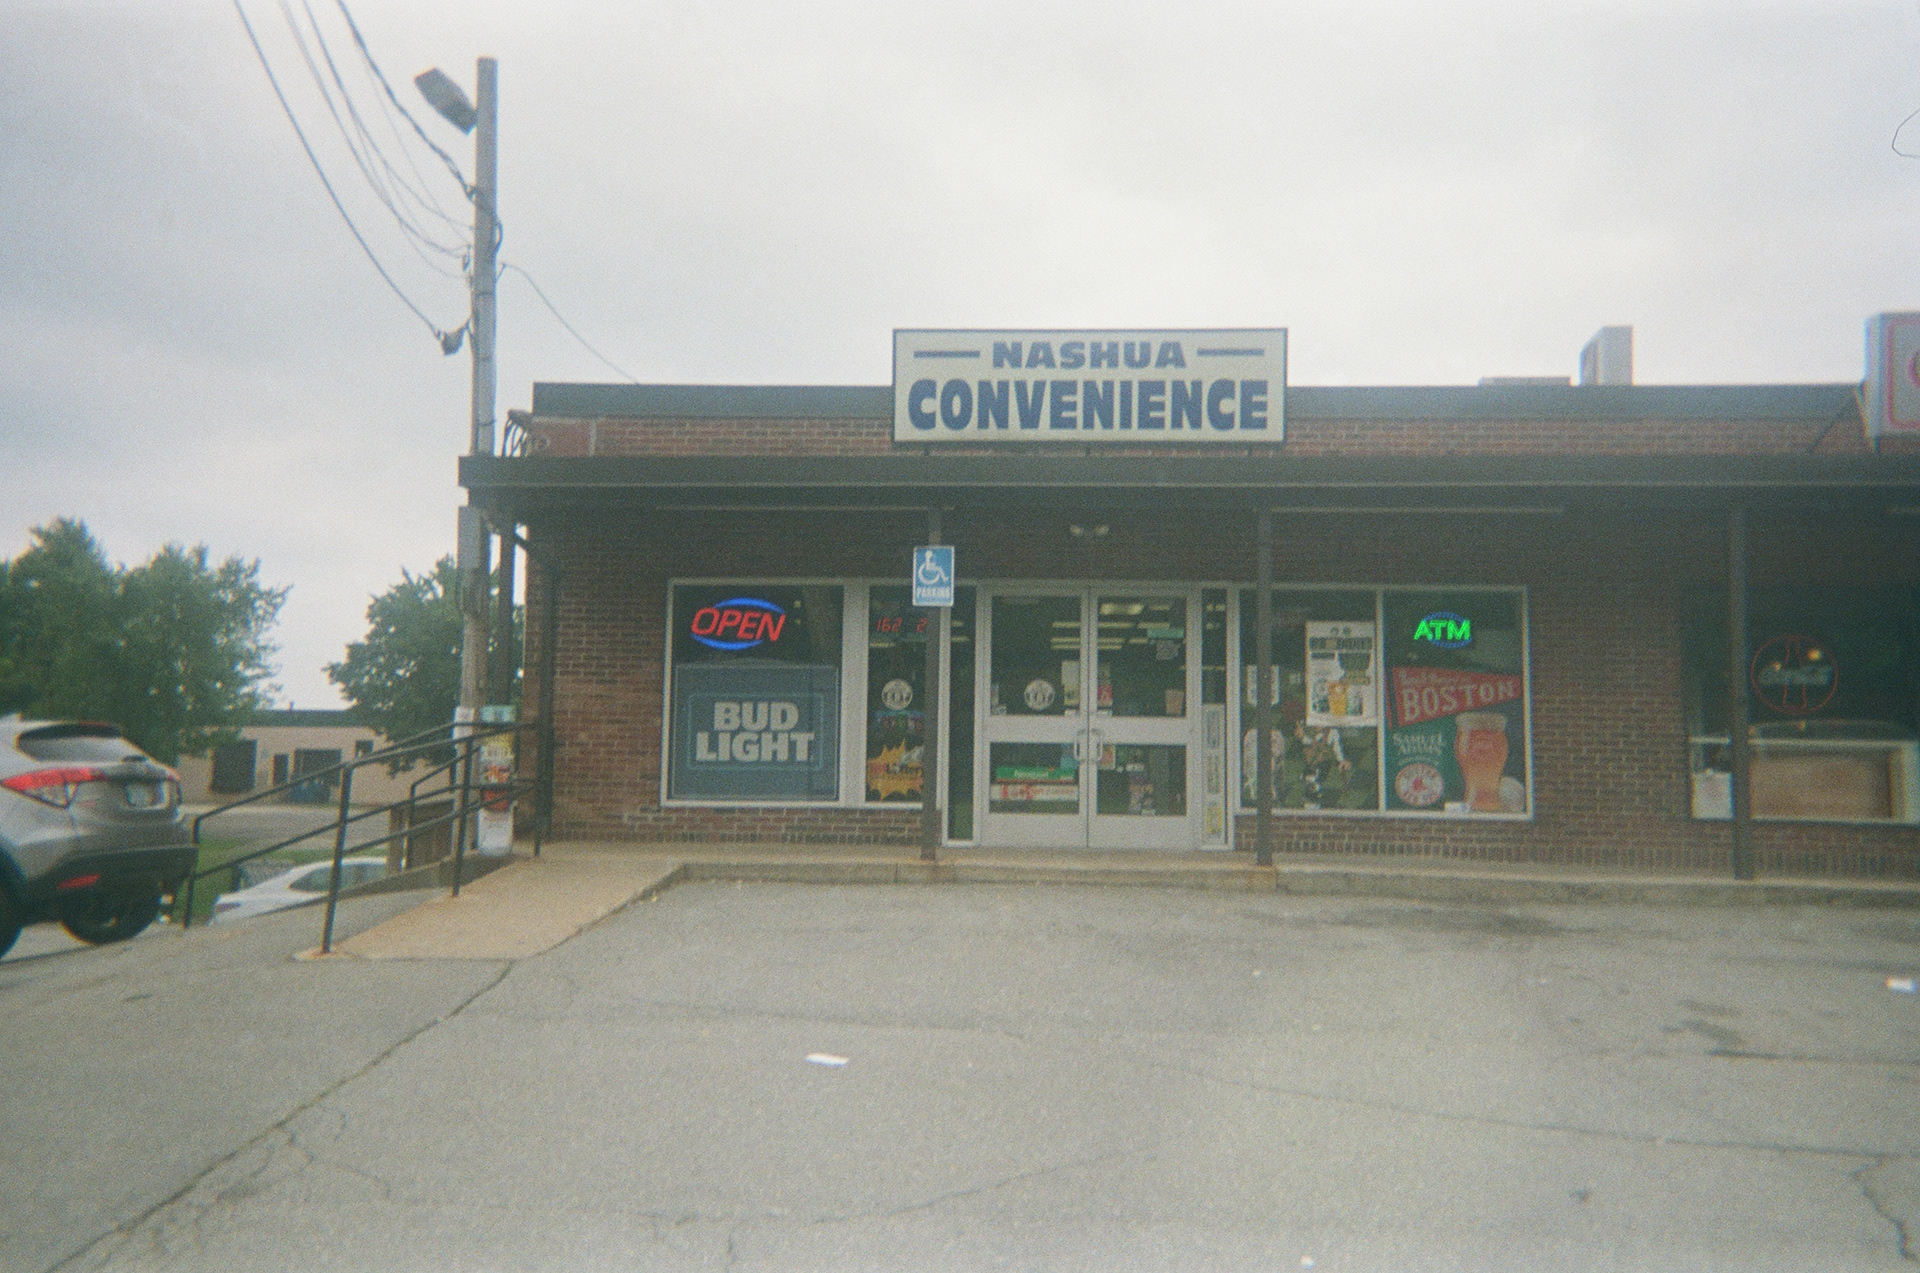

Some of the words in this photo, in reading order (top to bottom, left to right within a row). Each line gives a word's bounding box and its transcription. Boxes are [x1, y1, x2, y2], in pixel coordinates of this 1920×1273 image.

[992, 340, 1187, 370] NASHUA
[907, 378, 1269, 431] CONVENIENCE
[690, 606, 786, 642] OPEN
[1413, 619, 1471, 641] ATM
[712, 700, 799, 732] BUD
[1402, 681, 1515, 722] BOSTON
[694, 730, 815, 762] LIGHT
